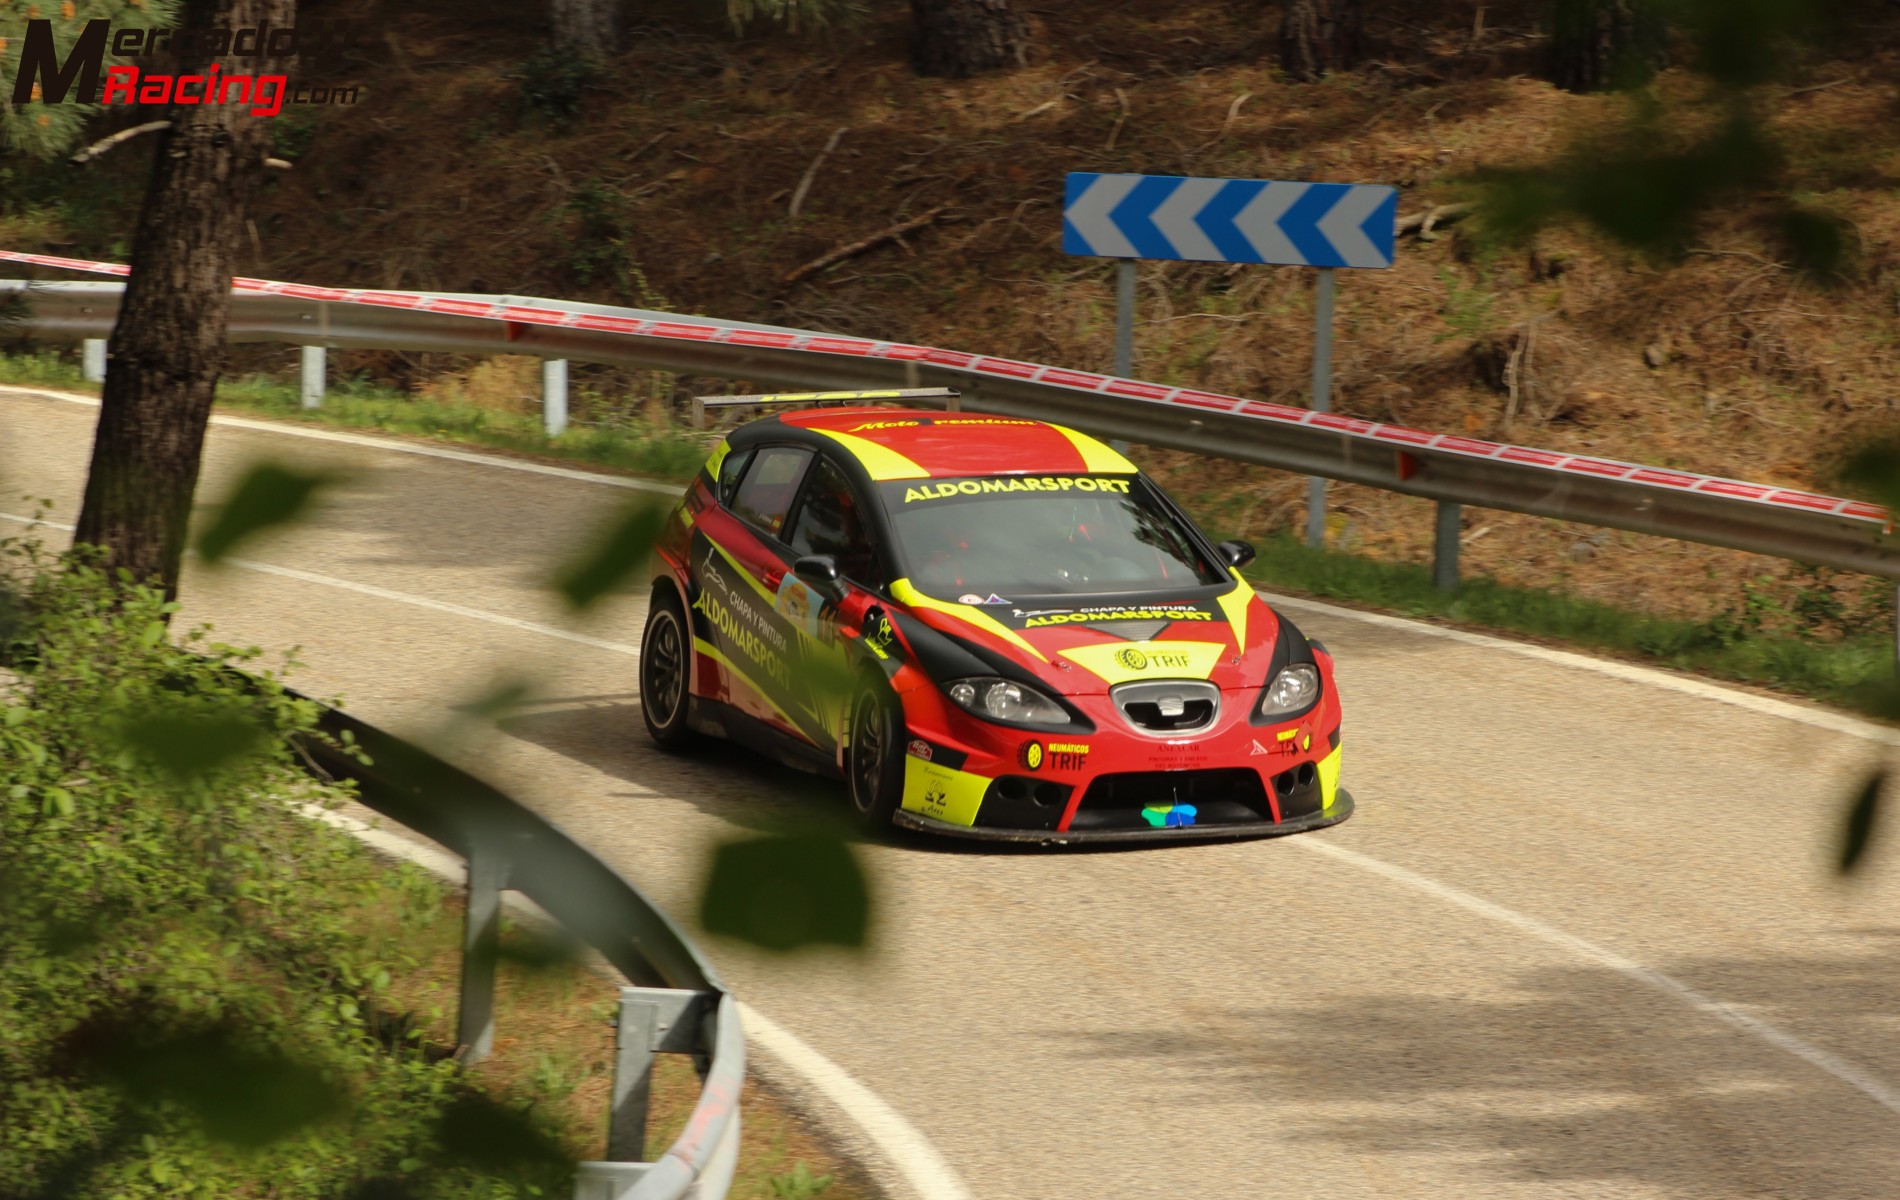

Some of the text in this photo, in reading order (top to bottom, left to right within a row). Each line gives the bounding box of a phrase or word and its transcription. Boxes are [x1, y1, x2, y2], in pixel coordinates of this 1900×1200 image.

[904, 476, 1131, 503] ALDOMARSPORT
[729, 590, 787, 655] CHAPA Y PINTURA
[1025, 610, 1212, 628] ALDOMARSPORT
[692, 587, 790, 691] ALDOMARSPORT
[1148, 655, 1191, 668] TRIF
[1049, 753, 1088, 771] TRIF
